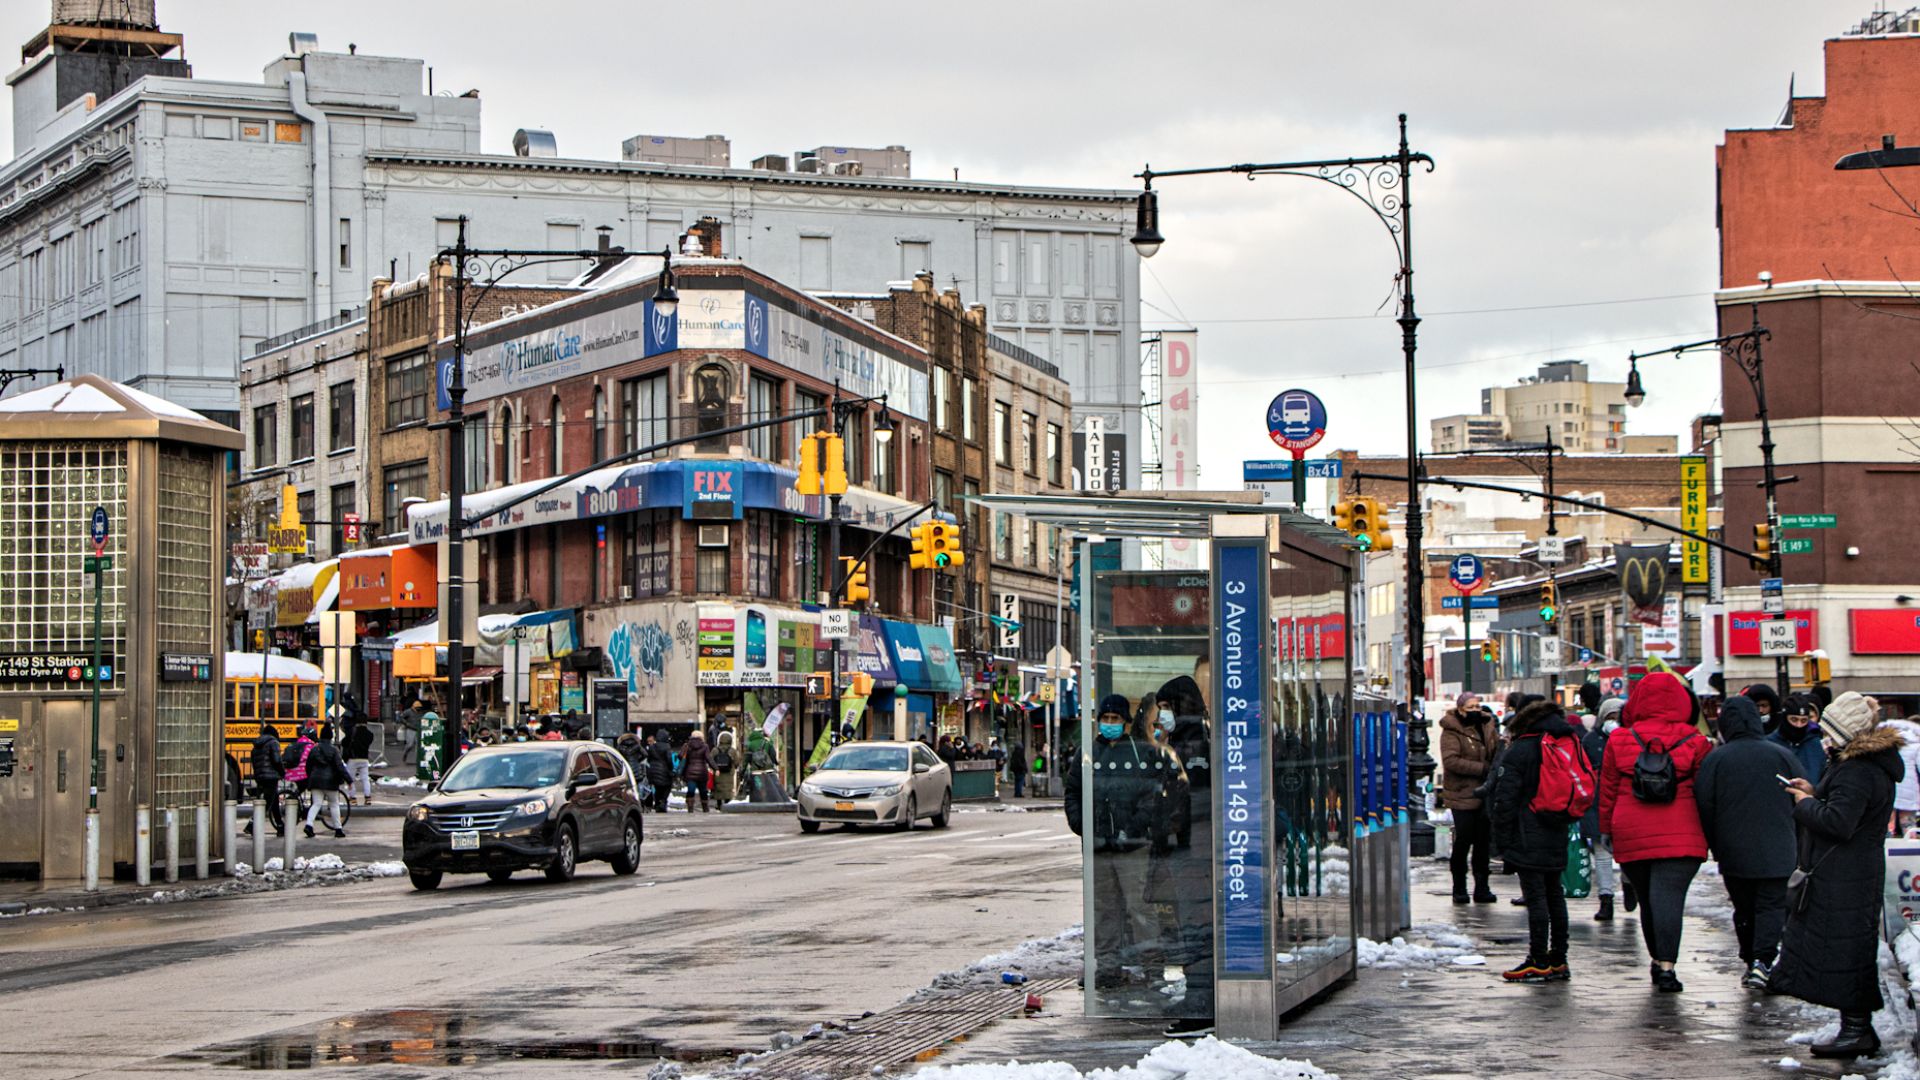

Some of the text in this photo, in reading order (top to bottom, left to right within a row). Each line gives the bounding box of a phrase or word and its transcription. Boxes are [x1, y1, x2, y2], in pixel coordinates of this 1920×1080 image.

[678, 319, 745, 330] HumanCare
[517, 331, 581, 371] HumanCare
[1273, 431, 1322, 449] NO STANDING
[1089, 419, 1101, 490] TATTOO
[1246, 462, 1289, 471] Williamsbridge
[1307, 463, 1338, 478] Bx41
[693, 471, 733, 492] FIX
[698, 492, 732, 500] 2nd Floor
[535, 499, 559, 516] Computer
[270, 529, 305, 548] FABRIC
[1546, 540, 1556, 548] NO
[1789, 540, 1802, 552] 149
[639, 555, 669, 574] LAPTOP
[829, 615, 841, 623] NO
[823, 626, 848, 634] TURNS
[1770, 626, 1786, 636] NO
[1545, 642, 1555, 652] NO
[1763, 640, 1796, 650] TURNS
[31, 656, 45, 667] St
[47, 656, 89, 667] Station
[8, 668, 18, 677] St
[30, 668, 51, 677] Dyre
[52, 668, 63, 676] Av
[1225, 580, 1249, 901] 3 Avenue & East 149 Street
